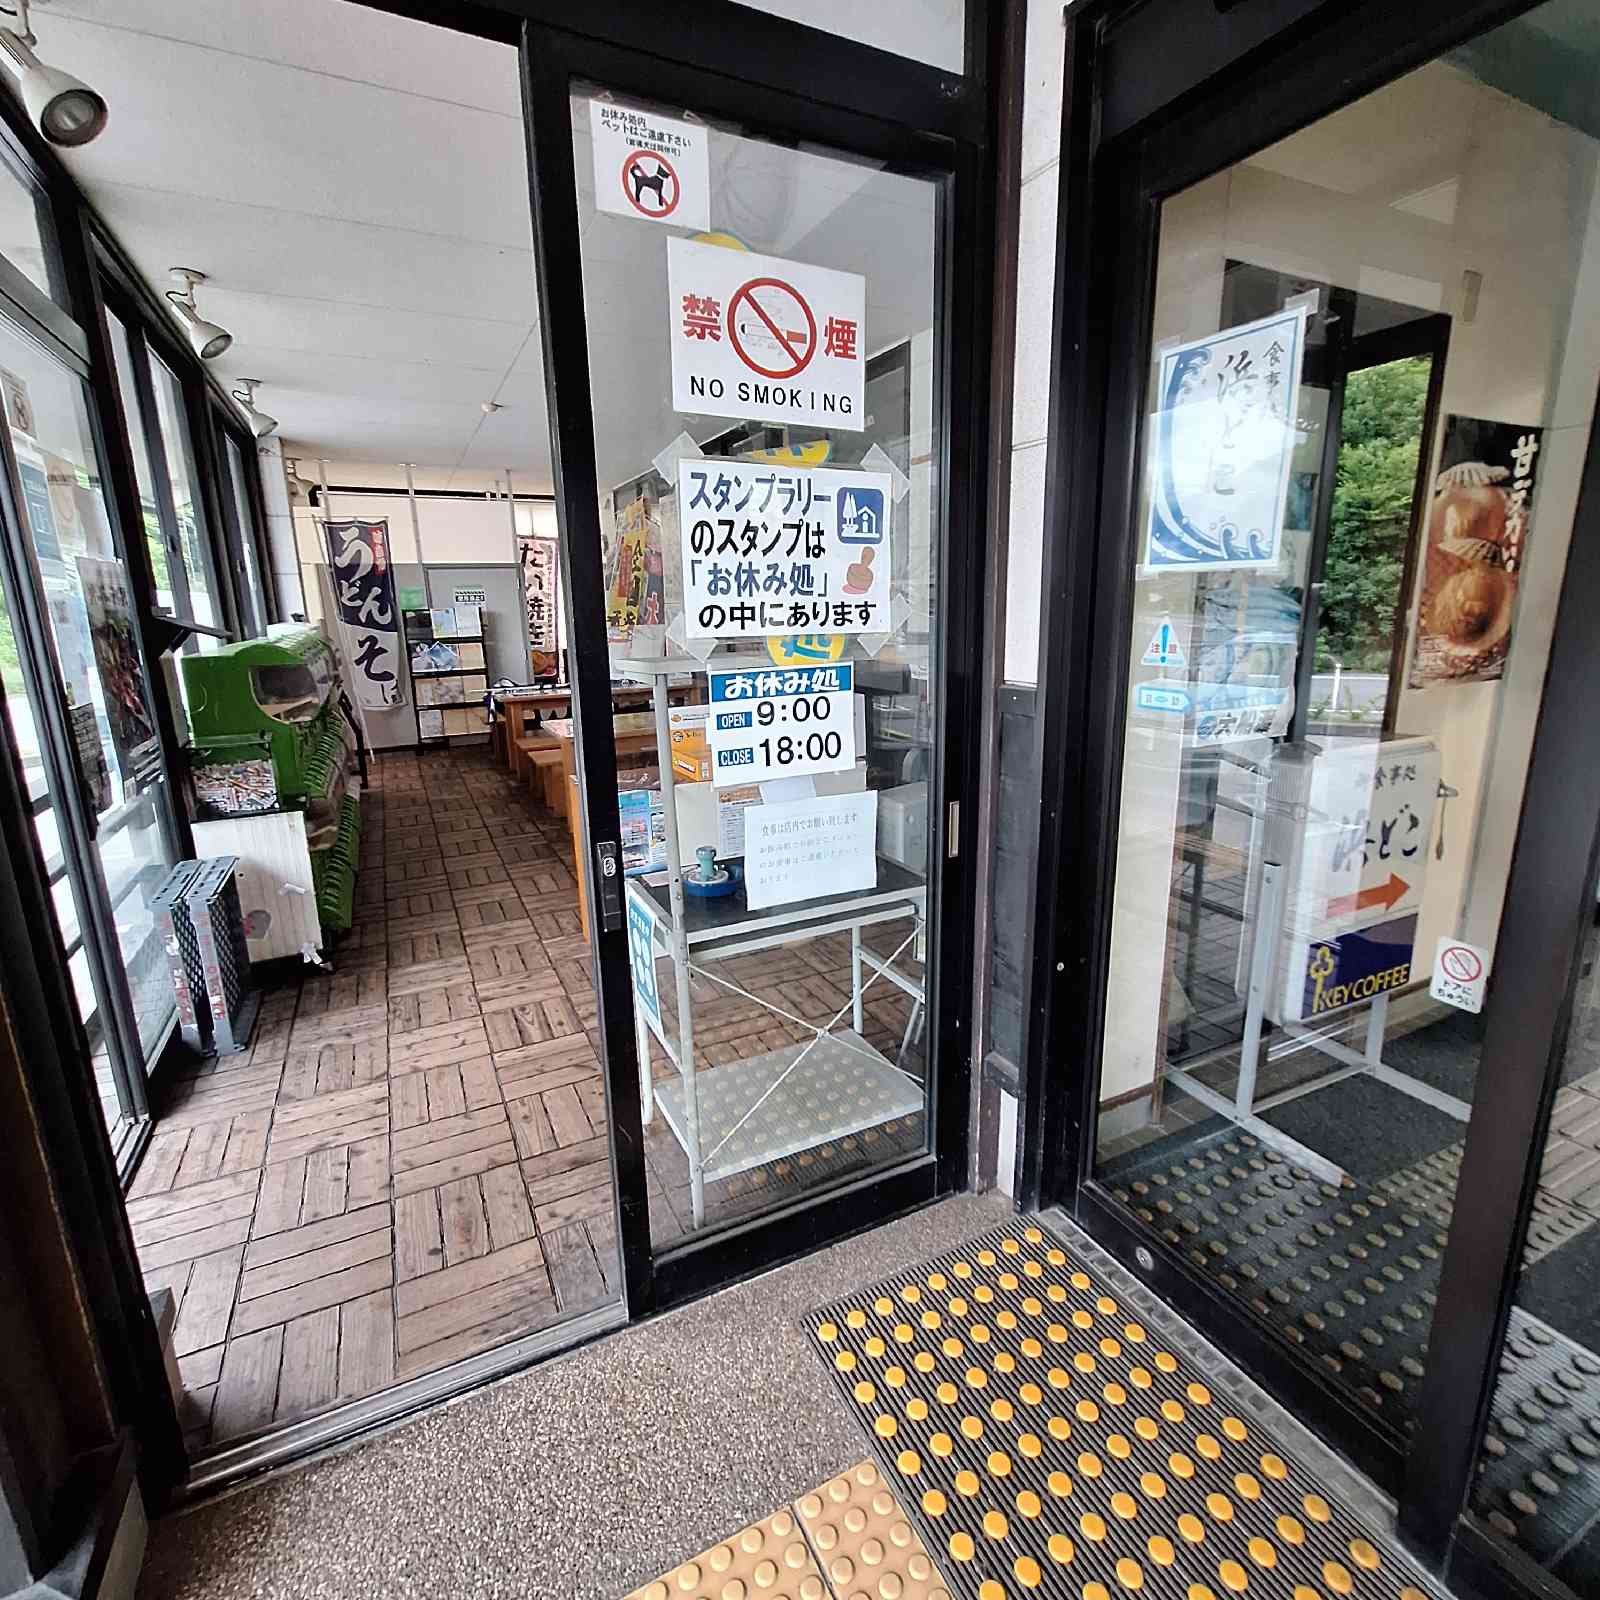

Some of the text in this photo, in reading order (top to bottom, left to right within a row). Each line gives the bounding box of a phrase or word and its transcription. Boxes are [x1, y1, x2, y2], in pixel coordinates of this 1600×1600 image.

[602, 120, 692, 147] ペットはご遠慮下さい
[682, 293, 858, 360] 禁 煙
[690, 375, 852, 414] NO SMOKING
[688, 472, 832, 515] スタンプラリー
[690, 518, 826, 559] のスタンプは
[690, 559, 828, 598] 「お休み処」
[699, 600, 877, 630] の中にあります
[724, 668, 840, 699] お休み処
[721, 695, 832, 728] OPEN 9:00
[720, 731, 842, 767] CLOSE 18:00
